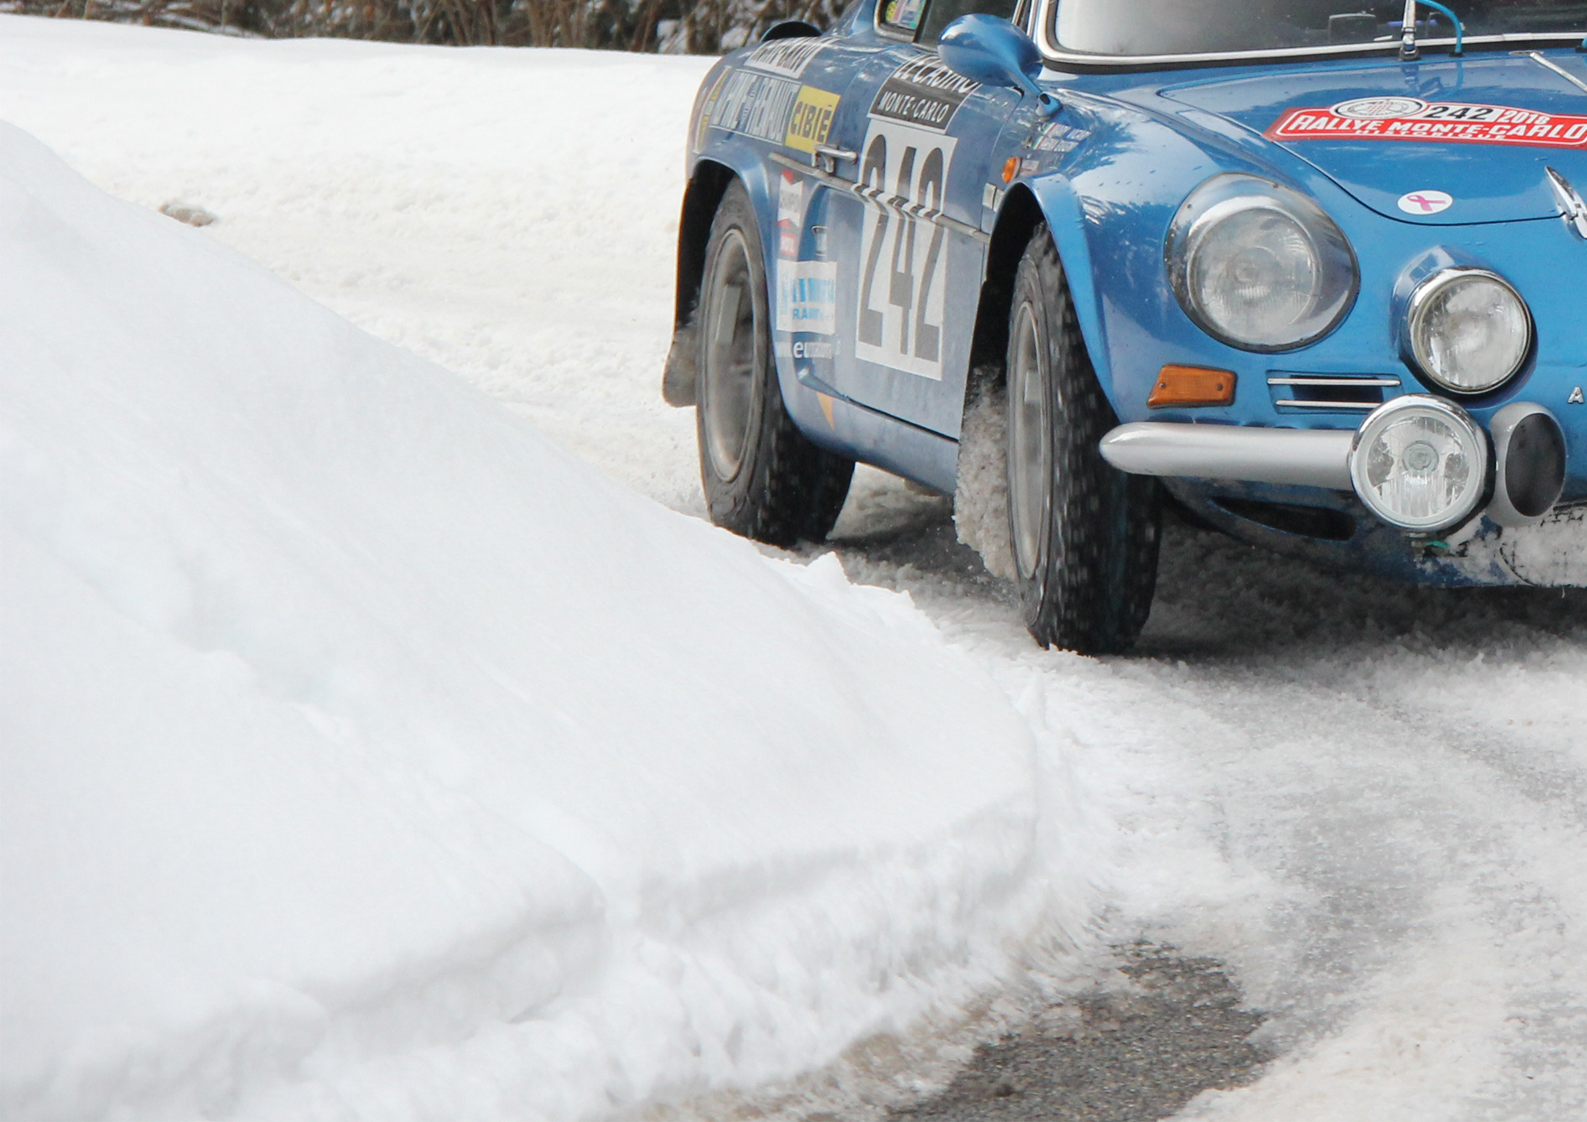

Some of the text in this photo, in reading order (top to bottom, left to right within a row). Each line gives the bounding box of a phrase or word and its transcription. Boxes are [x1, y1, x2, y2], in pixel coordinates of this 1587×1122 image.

[1287, 114, 1385, 131] RALLYE
[1422, 105, 1494, 121] 242
[1497, 109, 1551, 125] 2018
[858, 133, 944, 364] 242
